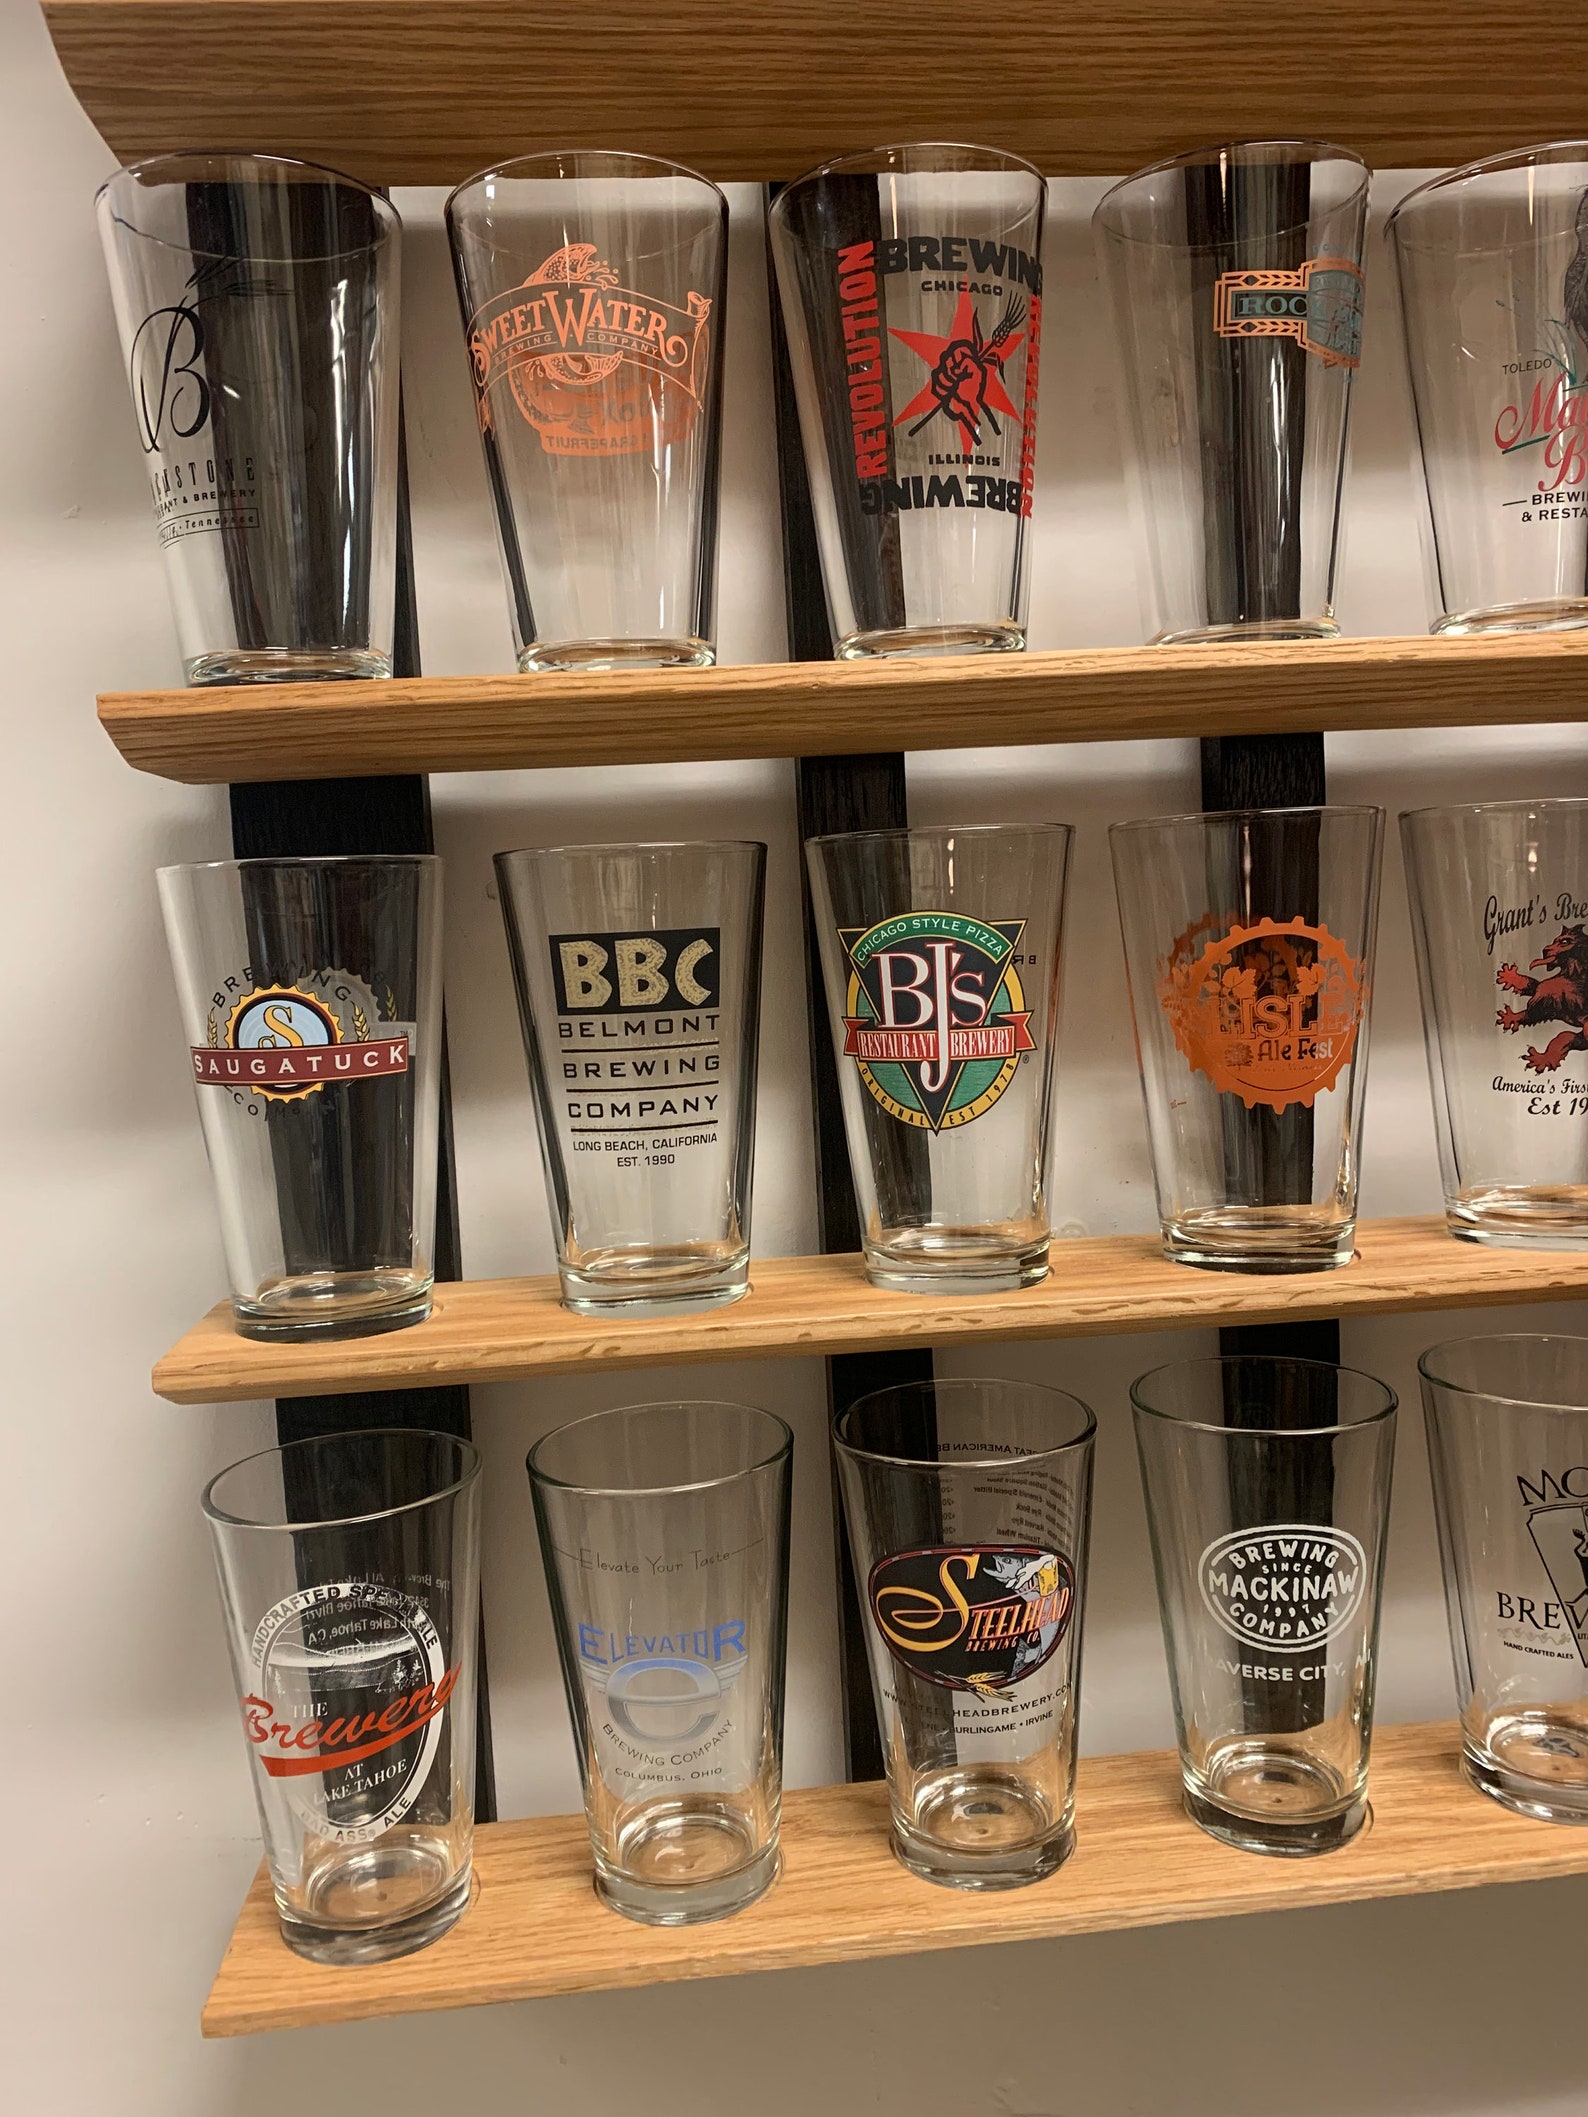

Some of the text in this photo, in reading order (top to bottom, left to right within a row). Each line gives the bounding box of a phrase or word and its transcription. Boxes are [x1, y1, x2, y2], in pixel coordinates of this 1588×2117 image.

[921, 280, 1003, 296] CHICAGO
[587, 332, 659, 356] COMPANY
[838, 240, 888, 479] REVOLUTION
[1502, 358, 1552, 375] TOLEDO
[928, 454, 1000, 467] ILLINOIS
[859, 474, 1022, 517] BREWING
[1521, 511, 1532, 522] &
[1484, 895, 1547, 955] Grant's
[857, 918, 1003, 962] CHICAGO STYLE PIZZA
[559, 937, 714, 1009] BBC
[558, 1015, 720, 1038] BELMONT
[860, 1028, 1012, 1058] RESTAURANT BREWERY
[1258, 1037, 1333, 1061] Ale Fest
[194, 1044, 405, 1075] SAUGATUCK
[563, 1055, 720, 1079] BREWING
[861, 1062, 1015, 1126] ORIGINAL EST 1978
[1492, 1076, 1555, 1094] America's
[567, 1095, 719, 1118] COMPANY
[1527, 1097, 1561, 1115] Est
[573, 1133, 718, 1152] LONG BEACH, CALIFORNIA
[617, 1154, 675, 1168] EST. 1990
[580, 1548, 730, 1575] Elevate Your Taste
[1228, 1540, 1340, 1570] BREWING
[1262, 1562, 1313, 1574] SINCE
[1208, 1566, 1359, 1602] MACKINAW
[876, 1553, 1070, 1652] STEELHEAD
[1262, 1603, 1310, 1618] 1997
[252, 1586, 341, 1668] HANDCRAFTED
[1229, 1601, 1338, 1638] COMPANY
[578, 1619, 748, 1665] ELEVATOR
[964, 1636, 1018, 1653] BREWING
[1503, 1641, 1574, 1660] HAND CRAFTED ALES
[240, 1660, 462, 1750] Brewery
[291, 1702, 328, 1719] THE
[1025, 1710, 1053, 1727] IRVINE
[602, 1719, 733, 1766] BREWING COMPANY
[344, 1763, 364, 1781] AT
[354, 1759, 408, 1793] TAHOE
[690, 1767, 723, 1779] OHIO
[383, 1797, 412, 1829] ALE
